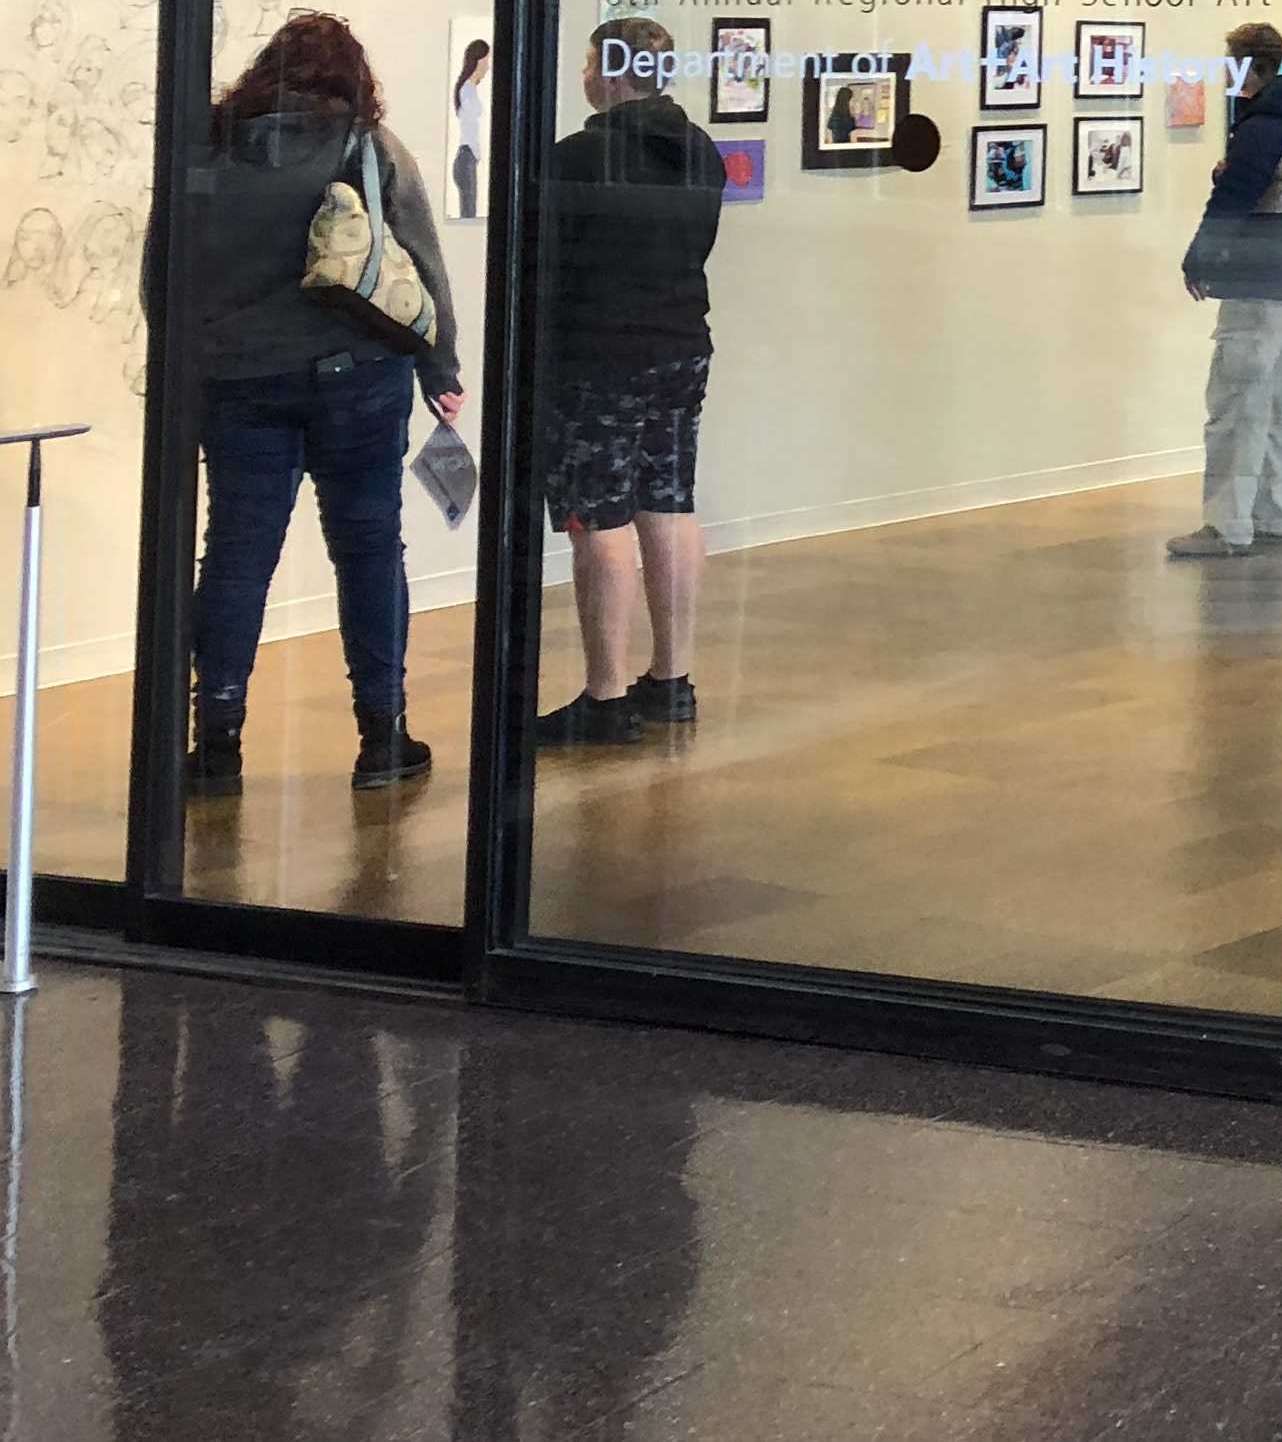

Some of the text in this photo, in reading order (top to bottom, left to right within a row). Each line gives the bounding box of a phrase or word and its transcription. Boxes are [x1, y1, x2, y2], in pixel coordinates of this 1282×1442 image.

[601, 38, 841, 89] Department
[851, 37, 894, 79] of
[1091, 42, 1253, 97] History
